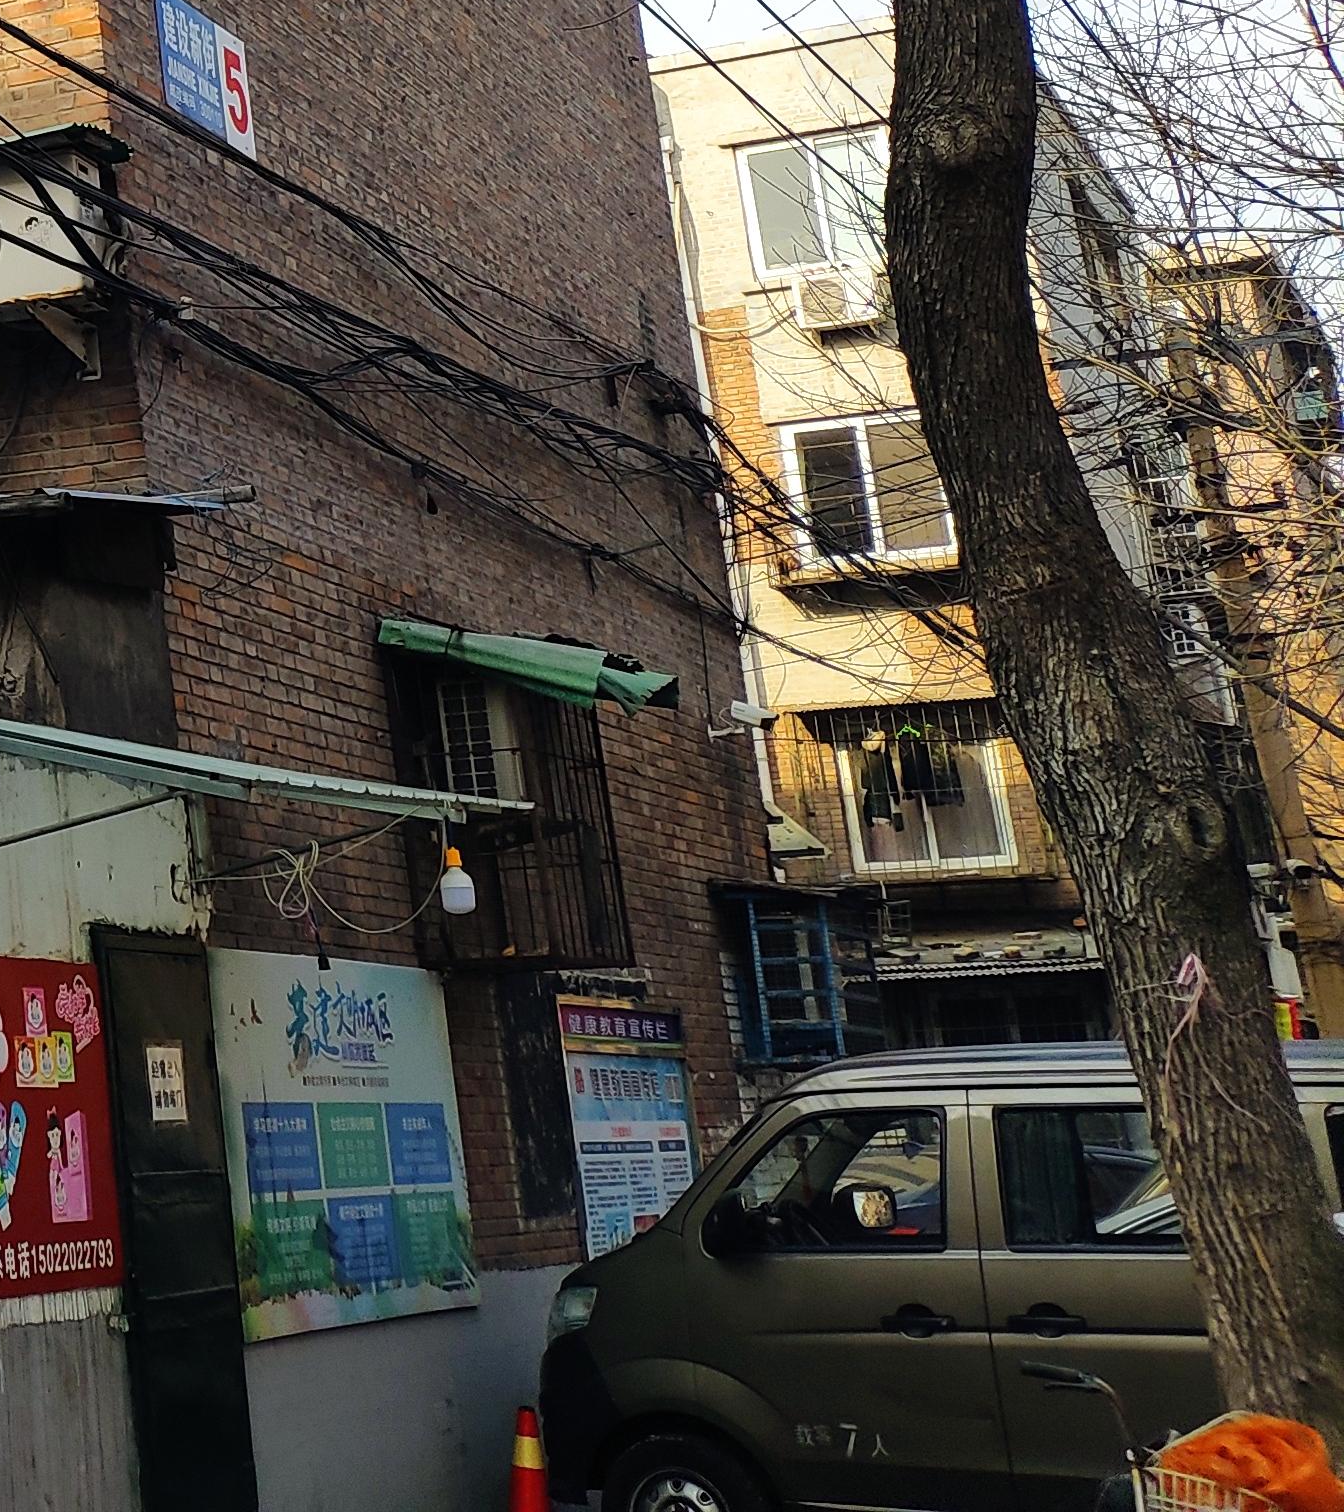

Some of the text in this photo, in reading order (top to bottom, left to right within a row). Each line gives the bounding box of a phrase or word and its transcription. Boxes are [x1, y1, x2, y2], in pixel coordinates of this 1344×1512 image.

[224, 46, 249, 135] 5
[568, 1014, 669, 1039] 健康教育宣传栏
